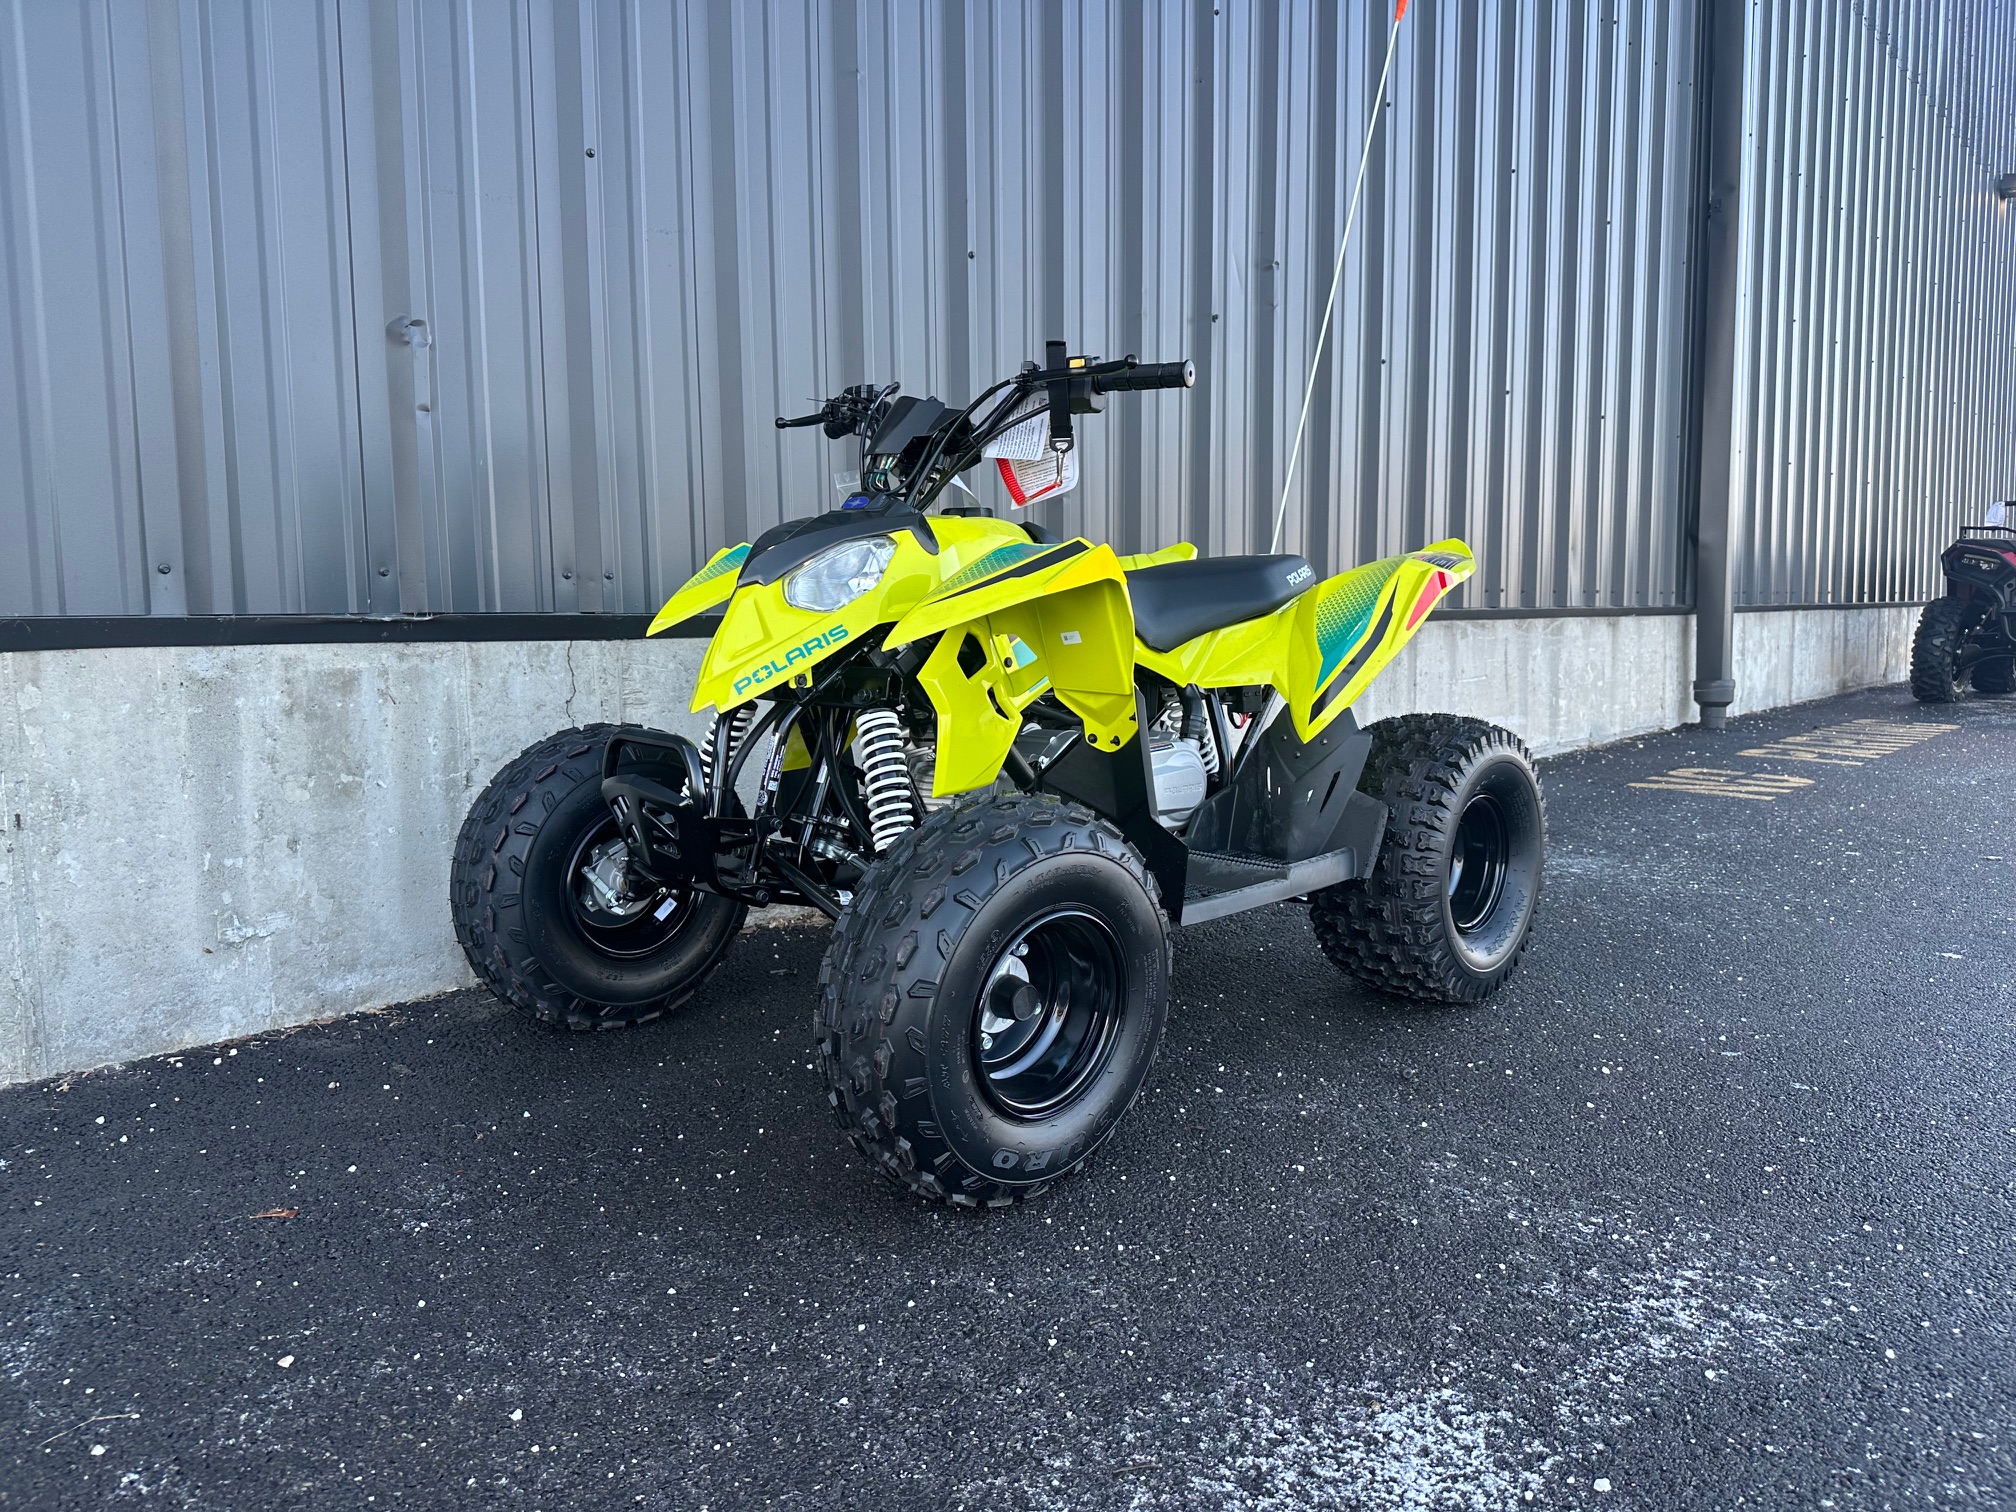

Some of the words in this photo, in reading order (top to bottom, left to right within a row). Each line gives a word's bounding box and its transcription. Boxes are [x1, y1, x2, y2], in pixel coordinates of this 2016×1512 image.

[1286, 565, 1312, 587] POLARIS
[733, 624, 849, 695] POLARIS
[1164, 783, 1203, 796] POLARIS
